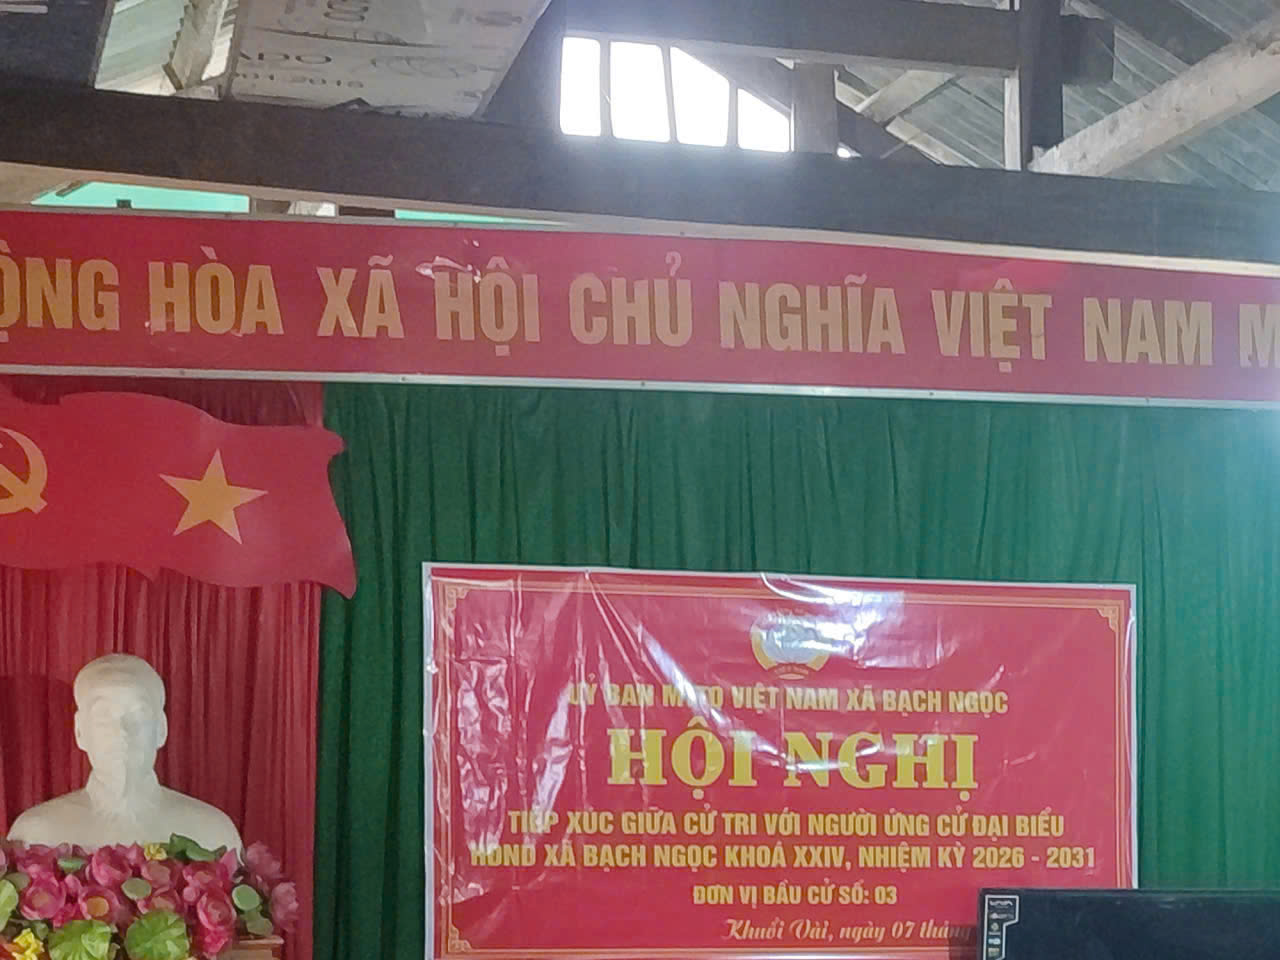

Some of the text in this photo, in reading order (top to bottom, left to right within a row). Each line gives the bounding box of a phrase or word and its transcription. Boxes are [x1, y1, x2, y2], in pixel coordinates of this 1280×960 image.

[148, 244, 285, 336] HÒA
[316, 254, 405, 339] XÃ
[433, 257, 541, 357] HỘI
[569, 252, 693, 347] CHỦ
[720, 275, 907, 354] NGHĨA
[931, 277, 1053, 374] VIỆT
[1083, 297, 1212, 367] NAM
[605, 683, 655, 707] BAN
[662, 684, 724, 710] MTQ
[731, 682, 779, 714] VIỆT
[785, 687, 838, 710] NAM
[847, 684, 876, 712] XÃ
[882, 689, 942, 717] BẠCH
[949, 690, 1008, 718] NGỌC
[607, 716, 979, 801] HỘI NGHỊ
[567, 806, 614, 835] XÚC
[621, 806, 677, 835] GIỮA
[684, 803, 718, 835] CỬ
[722, 812, 757, 835] TRI
[764, 807, 801, 836] VỚI
[808, 808, 877, 836] NGƯỜI
[884, 808, 930, 836] ỨNG
[936, 804, 969, 837] CỬ
[972, 815, 1009, 842] ĐẠI
[544, 839, 576, 867] XÃ
[583, 844, 646, 872] BẠCH
[654, 844, 717, 872] NGỌC
[725, 840, 787, 868] KHOÁ
[793, 845, 851, 871] XXIV,
[858, 841, 931, 873] NHIỆM
[938, 841, 966, 868] KỲ
[972, 847, 1025, 868] 2026
[1046, 847, 1095, 868] 2031
[692, 878, 898, 909] ĐƠN VỊ BẦU CỬ SỐ: 03
[839, 920, 886, 943] ngày
[891, 920, 916, 938] 07
